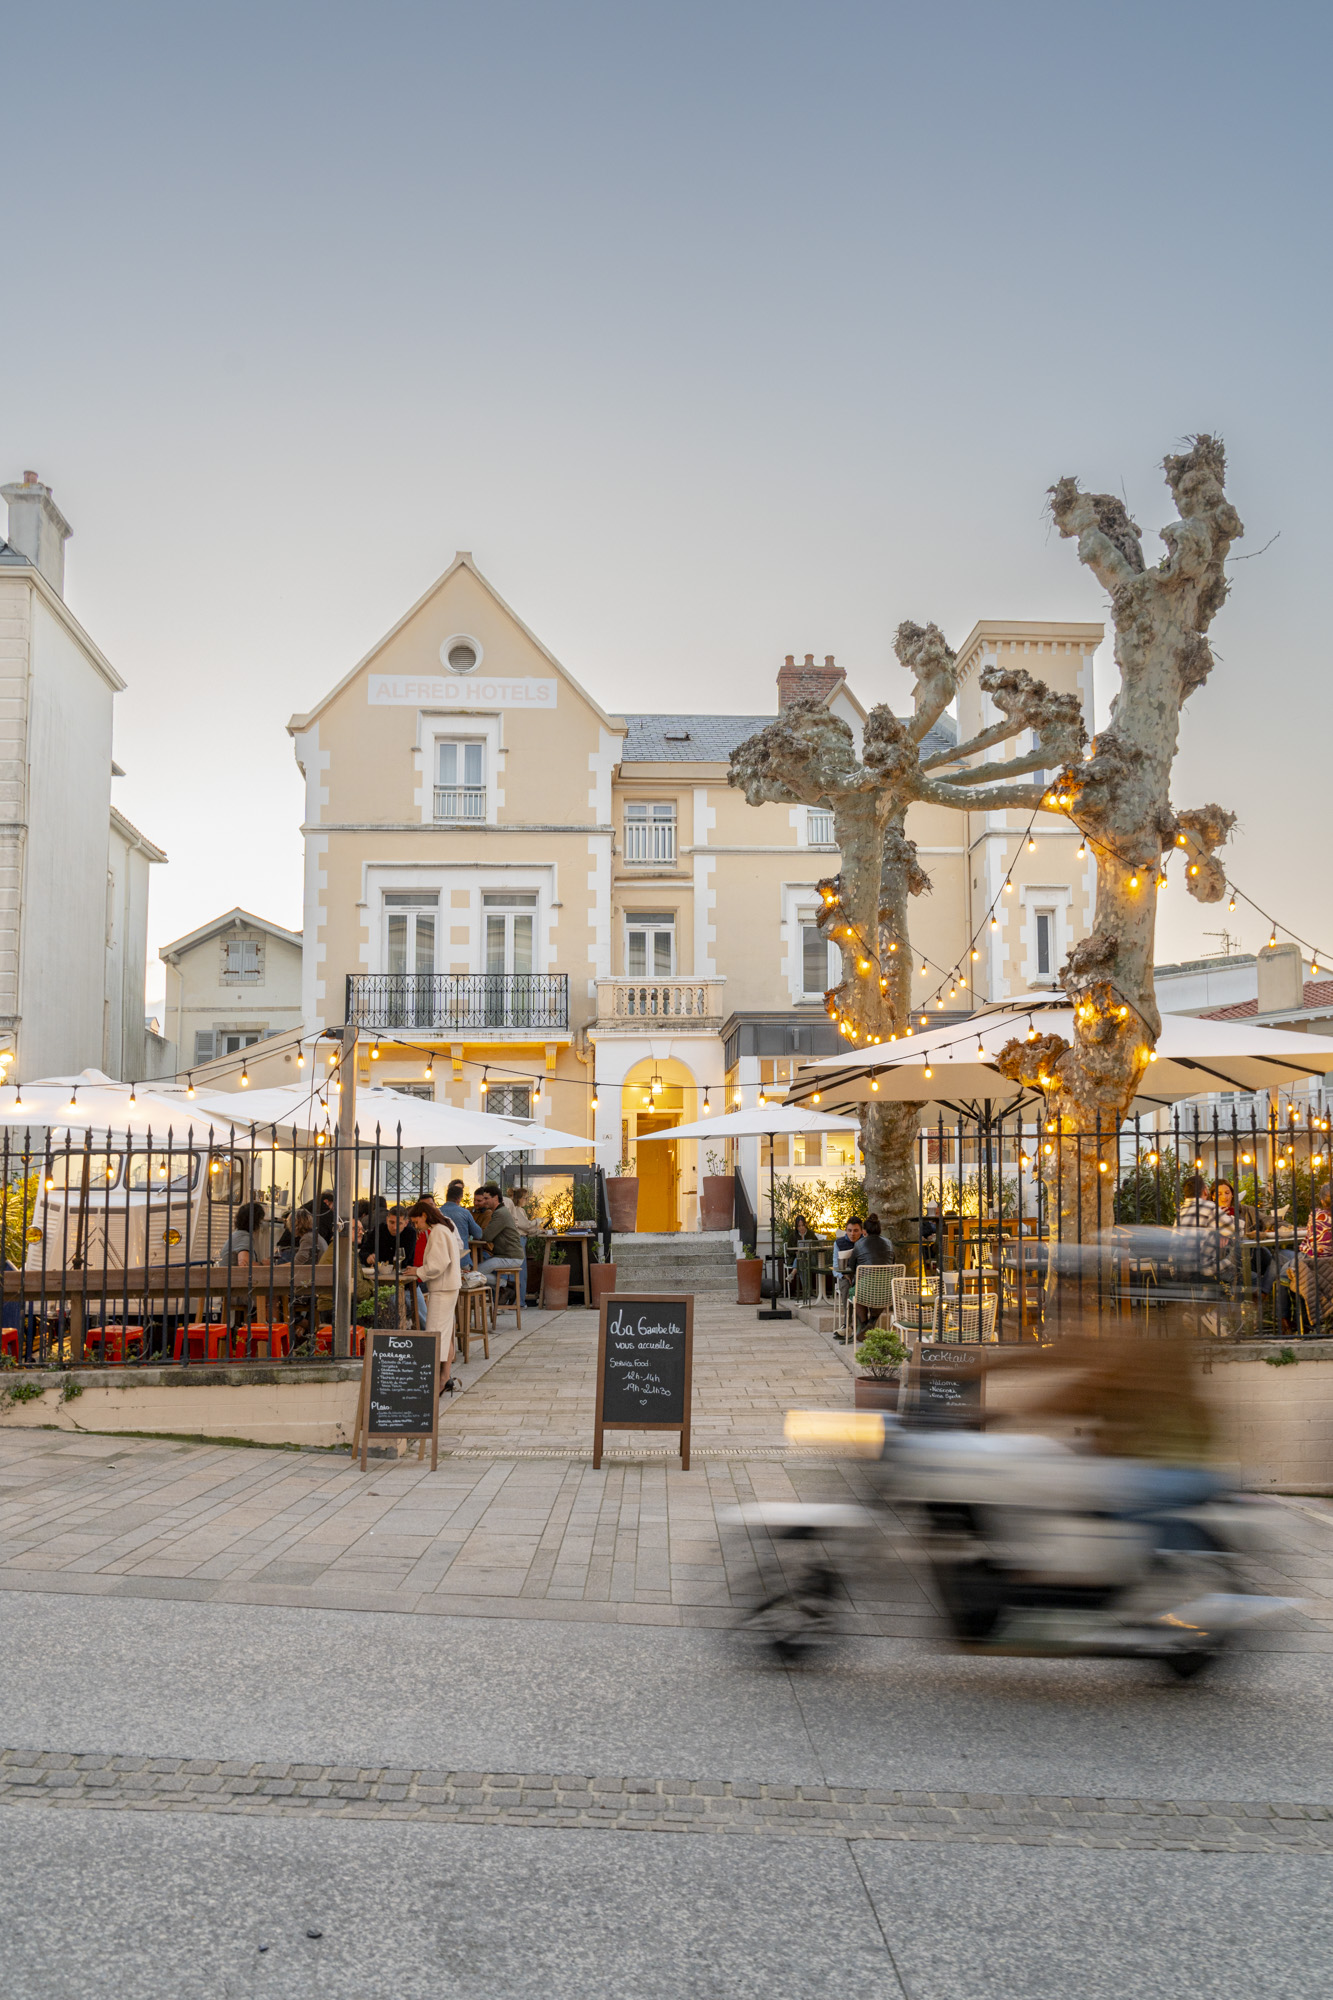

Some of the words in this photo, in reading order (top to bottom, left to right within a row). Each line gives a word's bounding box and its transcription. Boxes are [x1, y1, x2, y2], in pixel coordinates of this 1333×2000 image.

[375, 681, 460, 700] ALFRED
[466, 683, 550, 701] HOTELS
[638, 1316, 684, 1335] Gambette
[615, 1341, 635, 1350] vous
